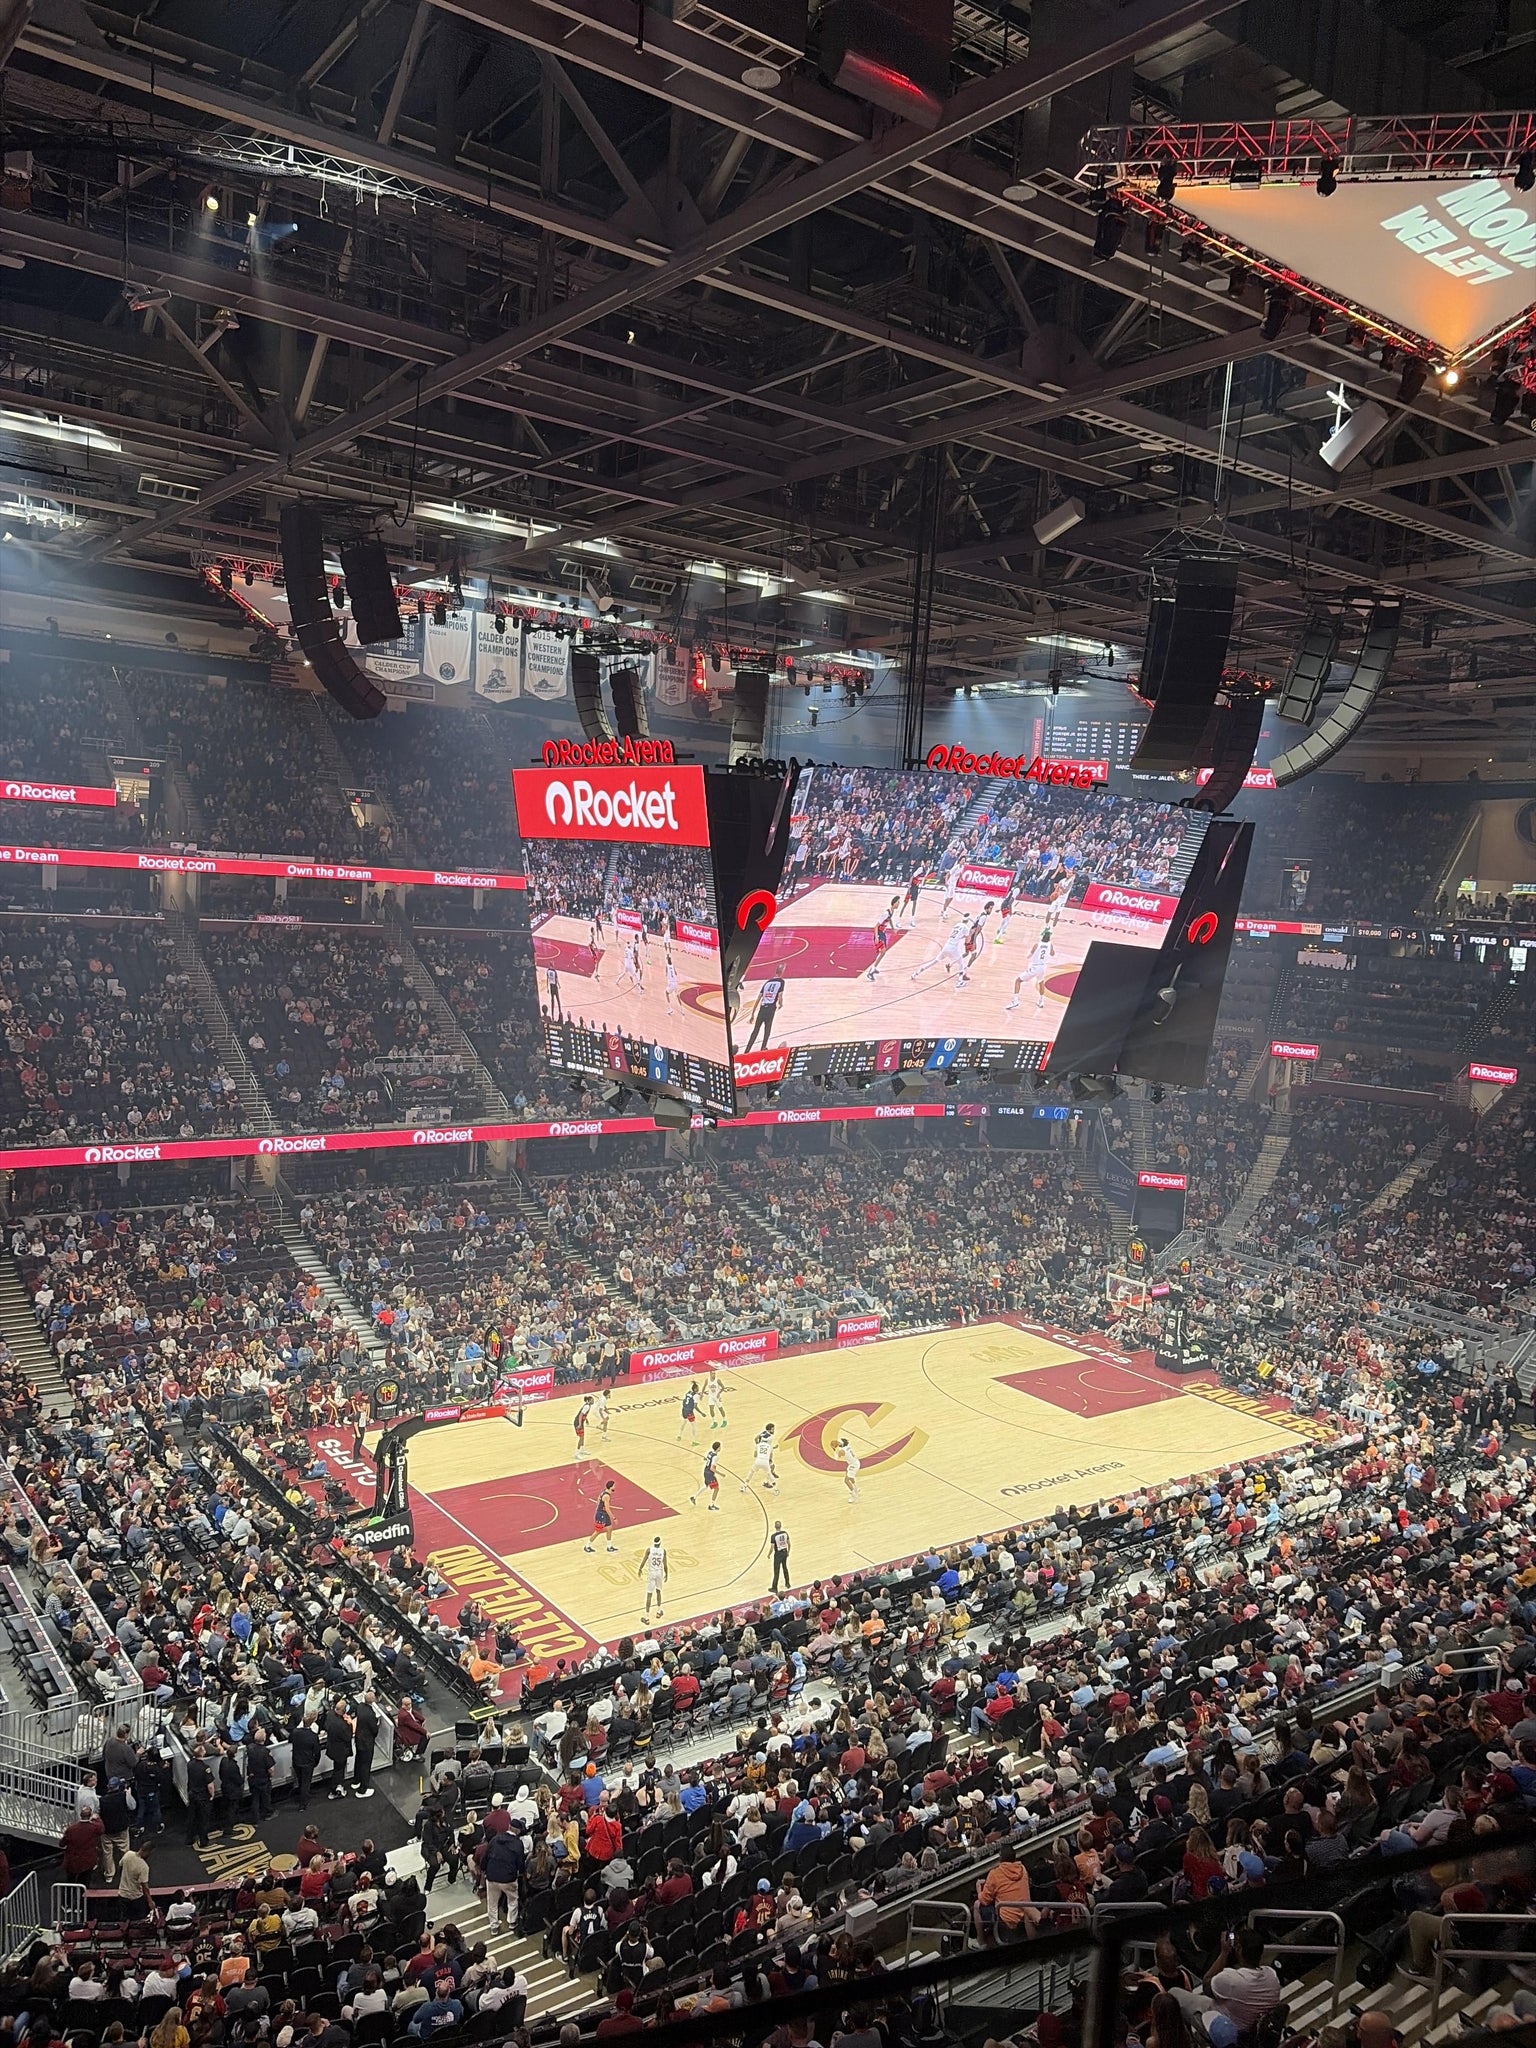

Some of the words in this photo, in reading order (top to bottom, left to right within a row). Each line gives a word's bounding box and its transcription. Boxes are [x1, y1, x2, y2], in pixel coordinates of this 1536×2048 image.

[1380, 204, 1458, 254] EM
[1436, 178, 1536, 269] NOW
[1423, 245, 1513, 285] LET
[429, 618, 468, 632] CMPIONS
[478, 632, 504, 645] CALDER
[506, 636, 519, 646] CUP
[478, 644, 518, 657] CHAMPIONS
[533, 643, 562, 654] WESTERN
[528, 653, 566, 666] CONFERENCE
[529, 663, 564, 676] CHAMPIONS
[558, 736, 621, 766] Rocket
[624, 735, 674, 764] Arena
[947, 745, 1026, 780] Rocket
[1024, 756, 1094, 788] Arena
[22, 784, 76, 801] Rocket
[573, 780, 678, 830] Rocket
[16, 850, 58, 862] Dream
[138, 856, 216, 872] Rocket.com
[287, 865, 312, 876] Own
[316, 866, 334, 877] the
[337, 869, 372, 880] Dream
[434, 874, 496, 886] Rocket.com
[973, 871, 1010, 888] Rocket
[1109, 890, 1160, 912] Rocket
[690, 926, 712, 940] Rocket
[1080, 922, 1138, 936] Arena
[1246, 922, 1276, 930] Dream
[1470, 936, 1496, 944] FOULS
[642, 1046, 648, 1055] 14
[1282, 1045, 1316, 1057] Rocket
[615, 1056, 620, 1069] 5
[630, 1064, 647, 1076] 10:45
[655, 1068, 661, 1079] 0
[884, 1056, 892, 1068] 5
[902, 1058, 925, 1068] 10:45
[936, 1056, 944, 1066] 0
[1482, 1068, 1514, 1080] Rocket
[787, 1109, 820, 1122] Rocket
[884, 1104, 914, 1118] Rocket
[427, 1128, 473, 1142] Rocket
[561, 1120, 603, 1136] Rocket
[274, 1136, 326, 1152] Rocket
[102, 1146, 160, 1162] Rocket
[1151, 1176, 1184, 1186] Rocket
[847, 1320, 878, 1333] Rocket
[729, 1336, 766, 1352] Rocket
[1052, 1334, 1132, 1364] CLIFFS
[654, 1348, 694, 1364] Rocket
[510, 1372, 552, 1387] Rocket
[619, 1395, 682, 1412] Rocket
[1183, 1382, 1335, 1440] CAVALIERS
[434, 1408, 458, 1418] Rocket
[317, 1438, 376, 1486] CLIFFS
[1014, 1472, 1078, 1494] Rocket
[1074, 1462, 1126, 1478] Arena
[366, 1524, 410, 1544] Redfin
[652, 1557, 661, 1566] 35
[428, 1544, 588, 1658] CLEVELAND
[779, 1602, 790, 1613] 45
